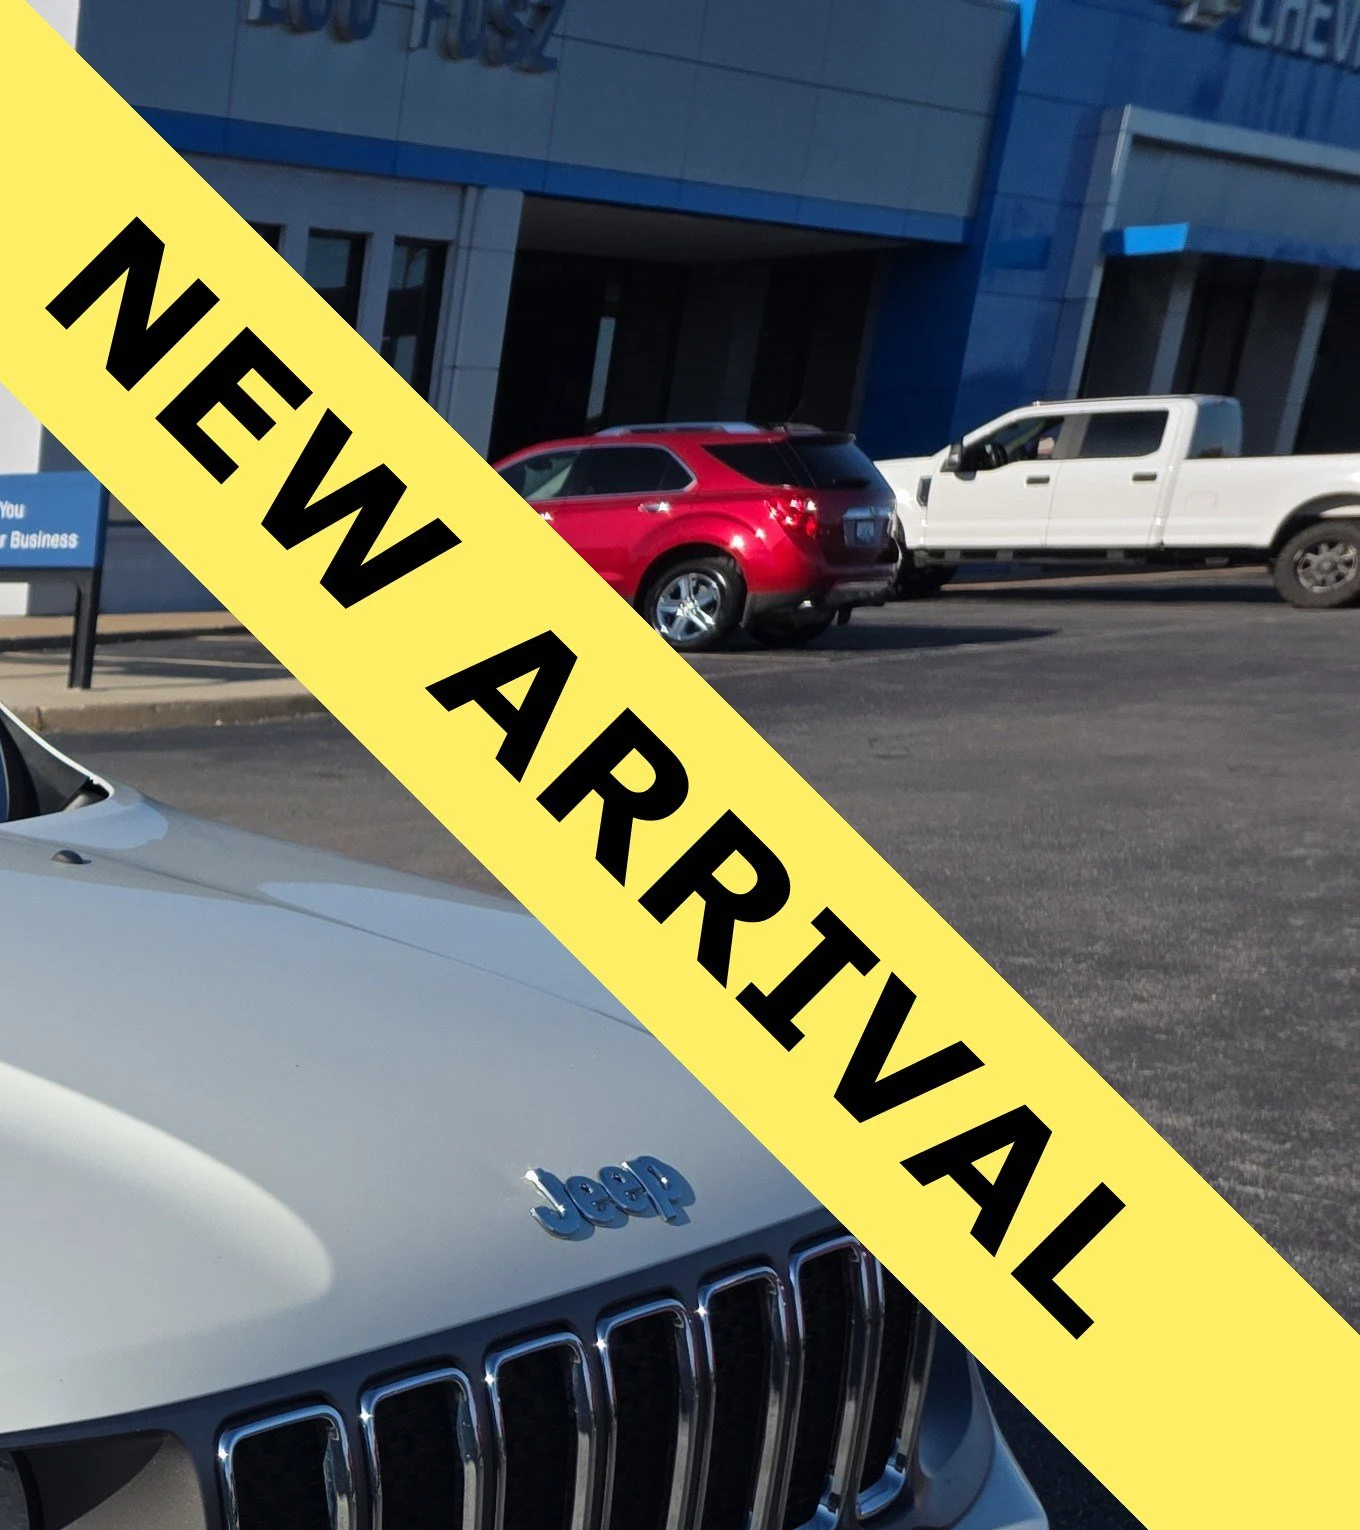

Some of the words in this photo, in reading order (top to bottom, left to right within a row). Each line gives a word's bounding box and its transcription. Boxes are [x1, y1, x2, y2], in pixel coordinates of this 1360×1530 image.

[0, 500, 25, 520] You
[10, 530, 79, 550] Business
[522, 1156, 688, 1240] Jeep
